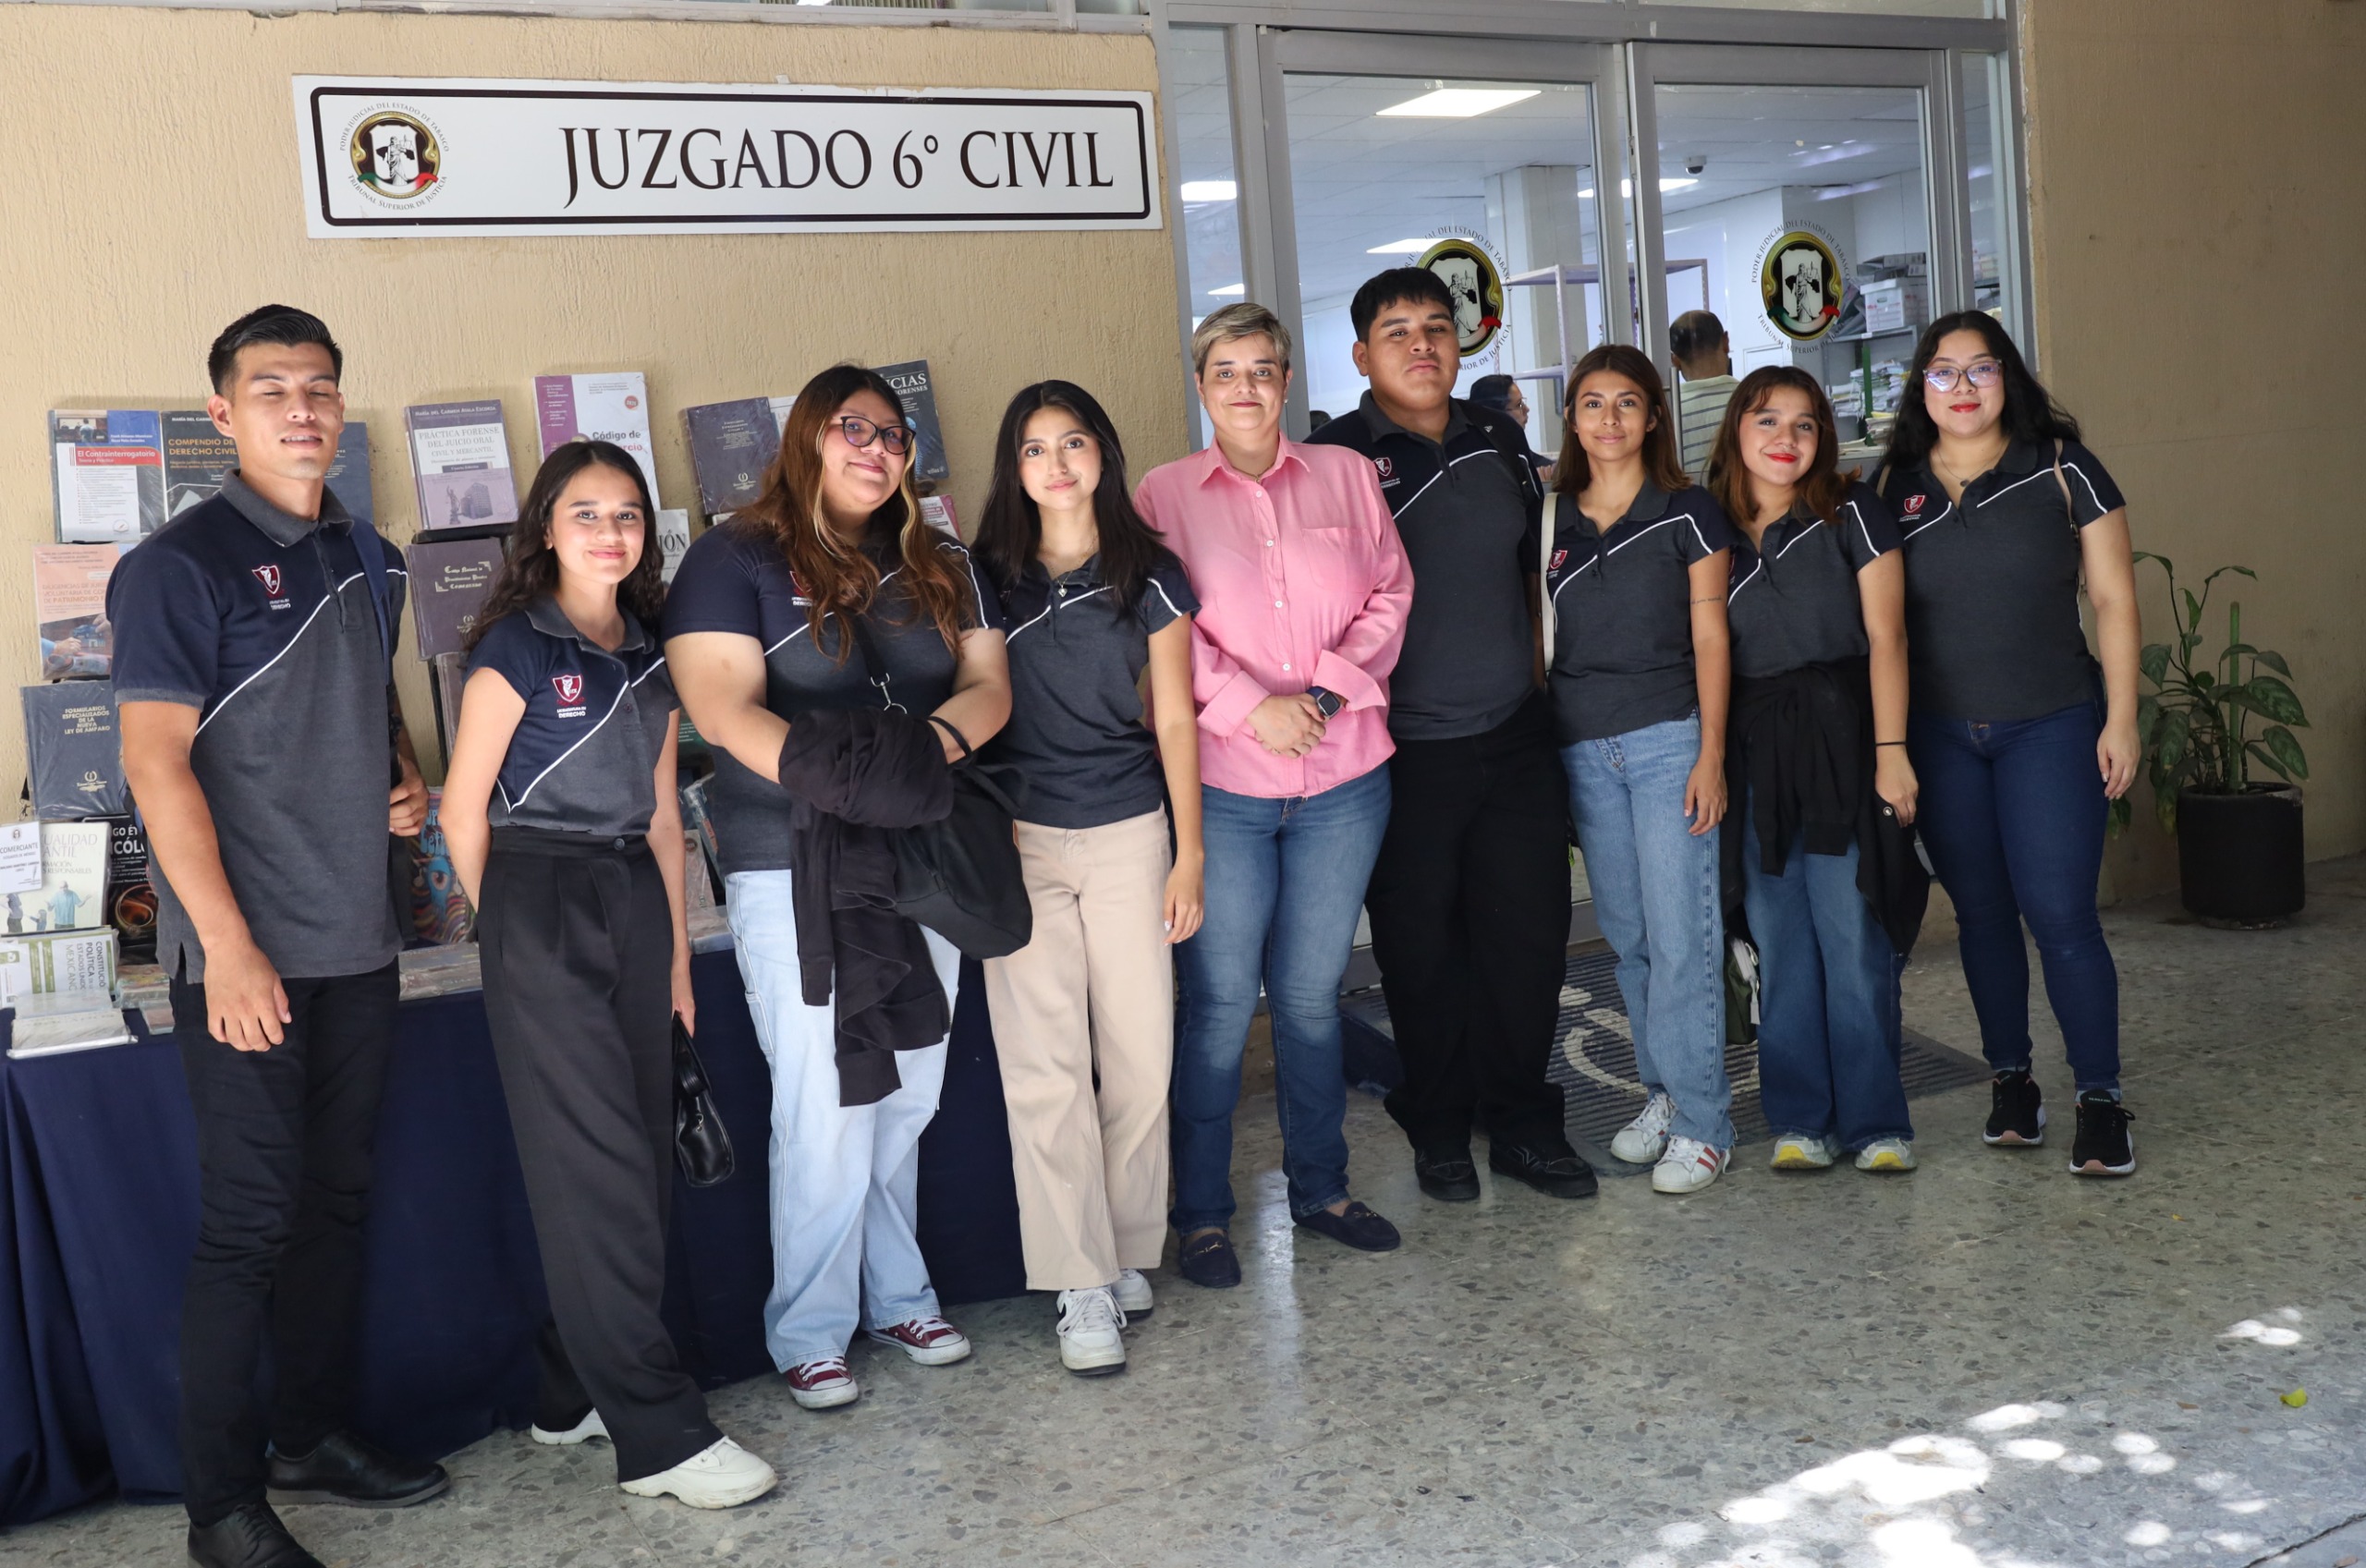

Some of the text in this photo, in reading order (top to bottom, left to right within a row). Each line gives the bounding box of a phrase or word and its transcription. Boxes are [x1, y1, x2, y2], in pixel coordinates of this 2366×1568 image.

[340, 126, 351, 152] PODER
[348, 105, 375, 131] JUDICIAL
[392, 102, 421, 115] ESTADO
[421, 113, 431, 122] DE
[431, 121, 449, 152] TABASCO
[558, 128, 872, 209] JUZGADO
[959, 130, 1114, 188] CIVIL
[348, 175, 447, 211] TRIBUNAL SUPERIOR DE JUSTICIA
[1438, 225, 1451, 235] DEL
[1455, 225, 1484, 243] ESTADO
[1484, 239, 1494, 251] DE
[1751, 253, 1762, 283] PODER
[1760, 225, 1786, 256] JUDICIAL
[1757, 312, 1785, 347] TRIBUNAL
[1479, 356, 1489, 366] DE
[1488, 324, 1512, 359] JUSTICIA
[888, 373, 927, 389] CIAS
[896, 384, 928, 395] ORENSES
[420, 426, 500, 440] PRÁCTICA FORENSE
[592, 431, 641, 442] Código de
[427, 440, 444, 448] DEL
[445, 438, 472, 446] JUICIO
[85, 449, 156, 458] Contrainterrogatorio
[53, 596, 100, 604] PATRIMONIO
[62, 710, 110, 719] ESPECIALIZADOS
[65, 705, 106, 714] FORMULARIOS
[43, 833, 98, 846] UALIDAD
[43, 846, 78, 857] ANTIL
[85, 942, 94, 978] POLÍTICA
[96, 941, 107, 988] CONSTITUCIÓ
